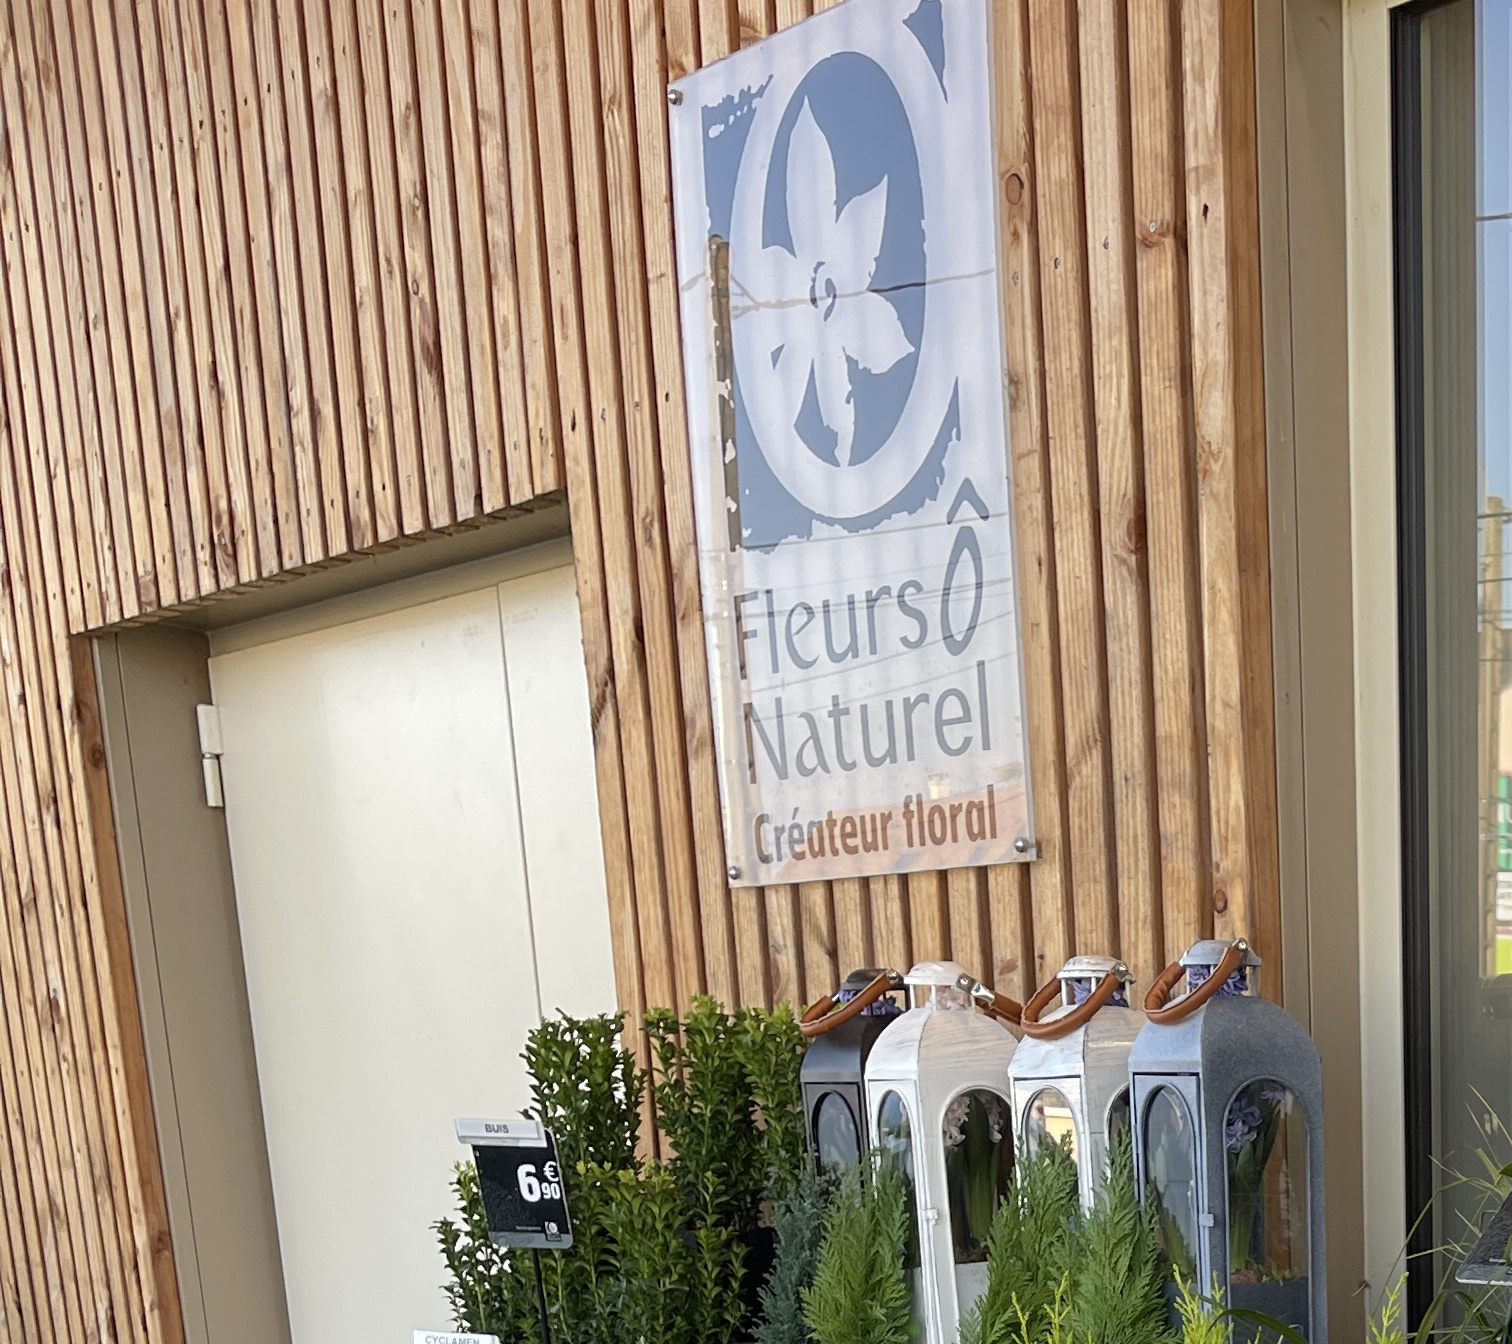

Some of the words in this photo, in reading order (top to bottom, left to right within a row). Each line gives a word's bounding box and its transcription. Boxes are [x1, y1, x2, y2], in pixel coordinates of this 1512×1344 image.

[733, 579, 928, 681] Fleurs
[743, 659, 992, 784] Naturel
[754, 806, 893, 865] Créateur
[902, 784, 998, 848] floral
[484, 1123, 509, 1134] BUIS
